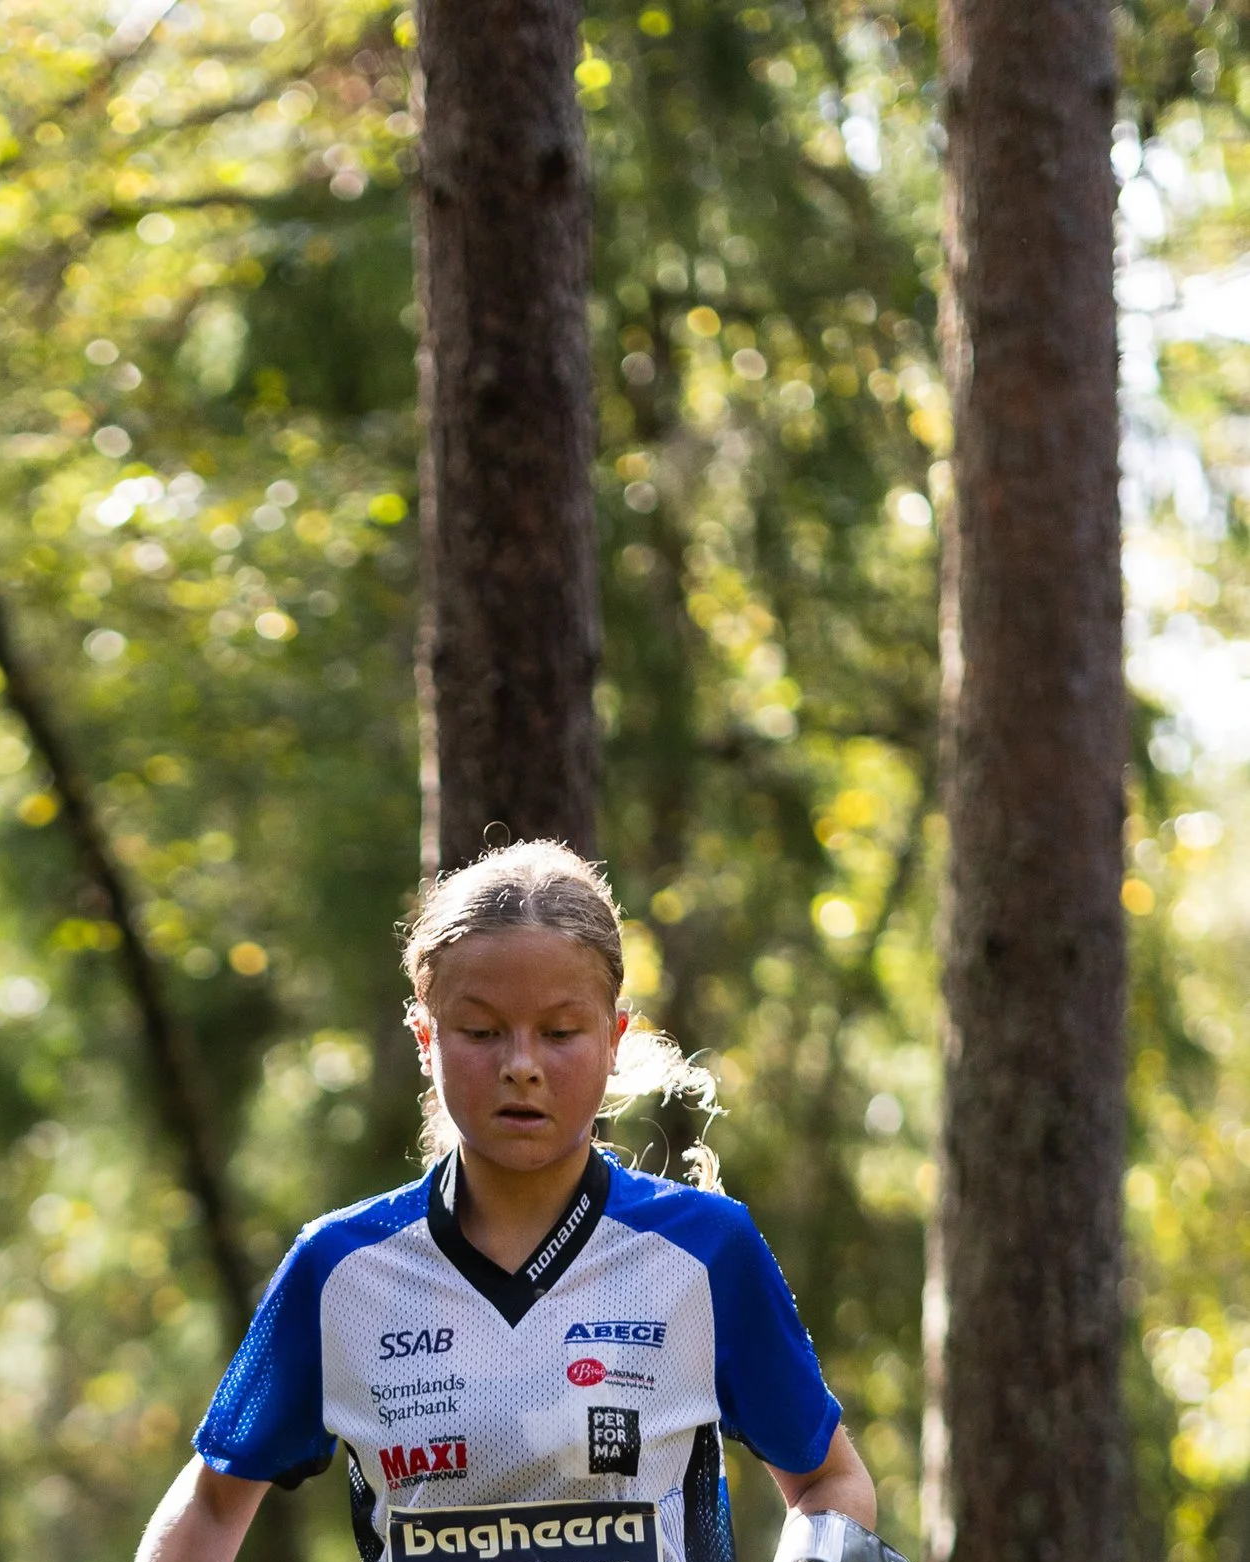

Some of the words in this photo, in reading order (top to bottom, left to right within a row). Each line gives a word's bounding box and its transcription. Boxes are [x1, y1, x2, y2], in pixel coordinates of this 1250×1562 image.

[526, 1193, 590, 1281] noname
[379, 1328, 454, 1360] SSAB
[564, 1323, 666, 1344] ABECE
[371, 1375, 466, 1403] Sörmlands
[378, 1396, 459, 1428] Sparbank
[593, 1413, 626, 1428] PER
[593, 1428, 626, 1443] FOR
[379, 1443, 467, 1480] MAXI
[593, 1444, 621, 1458] MA
[403, 1514, 645, 1559] bagheera
